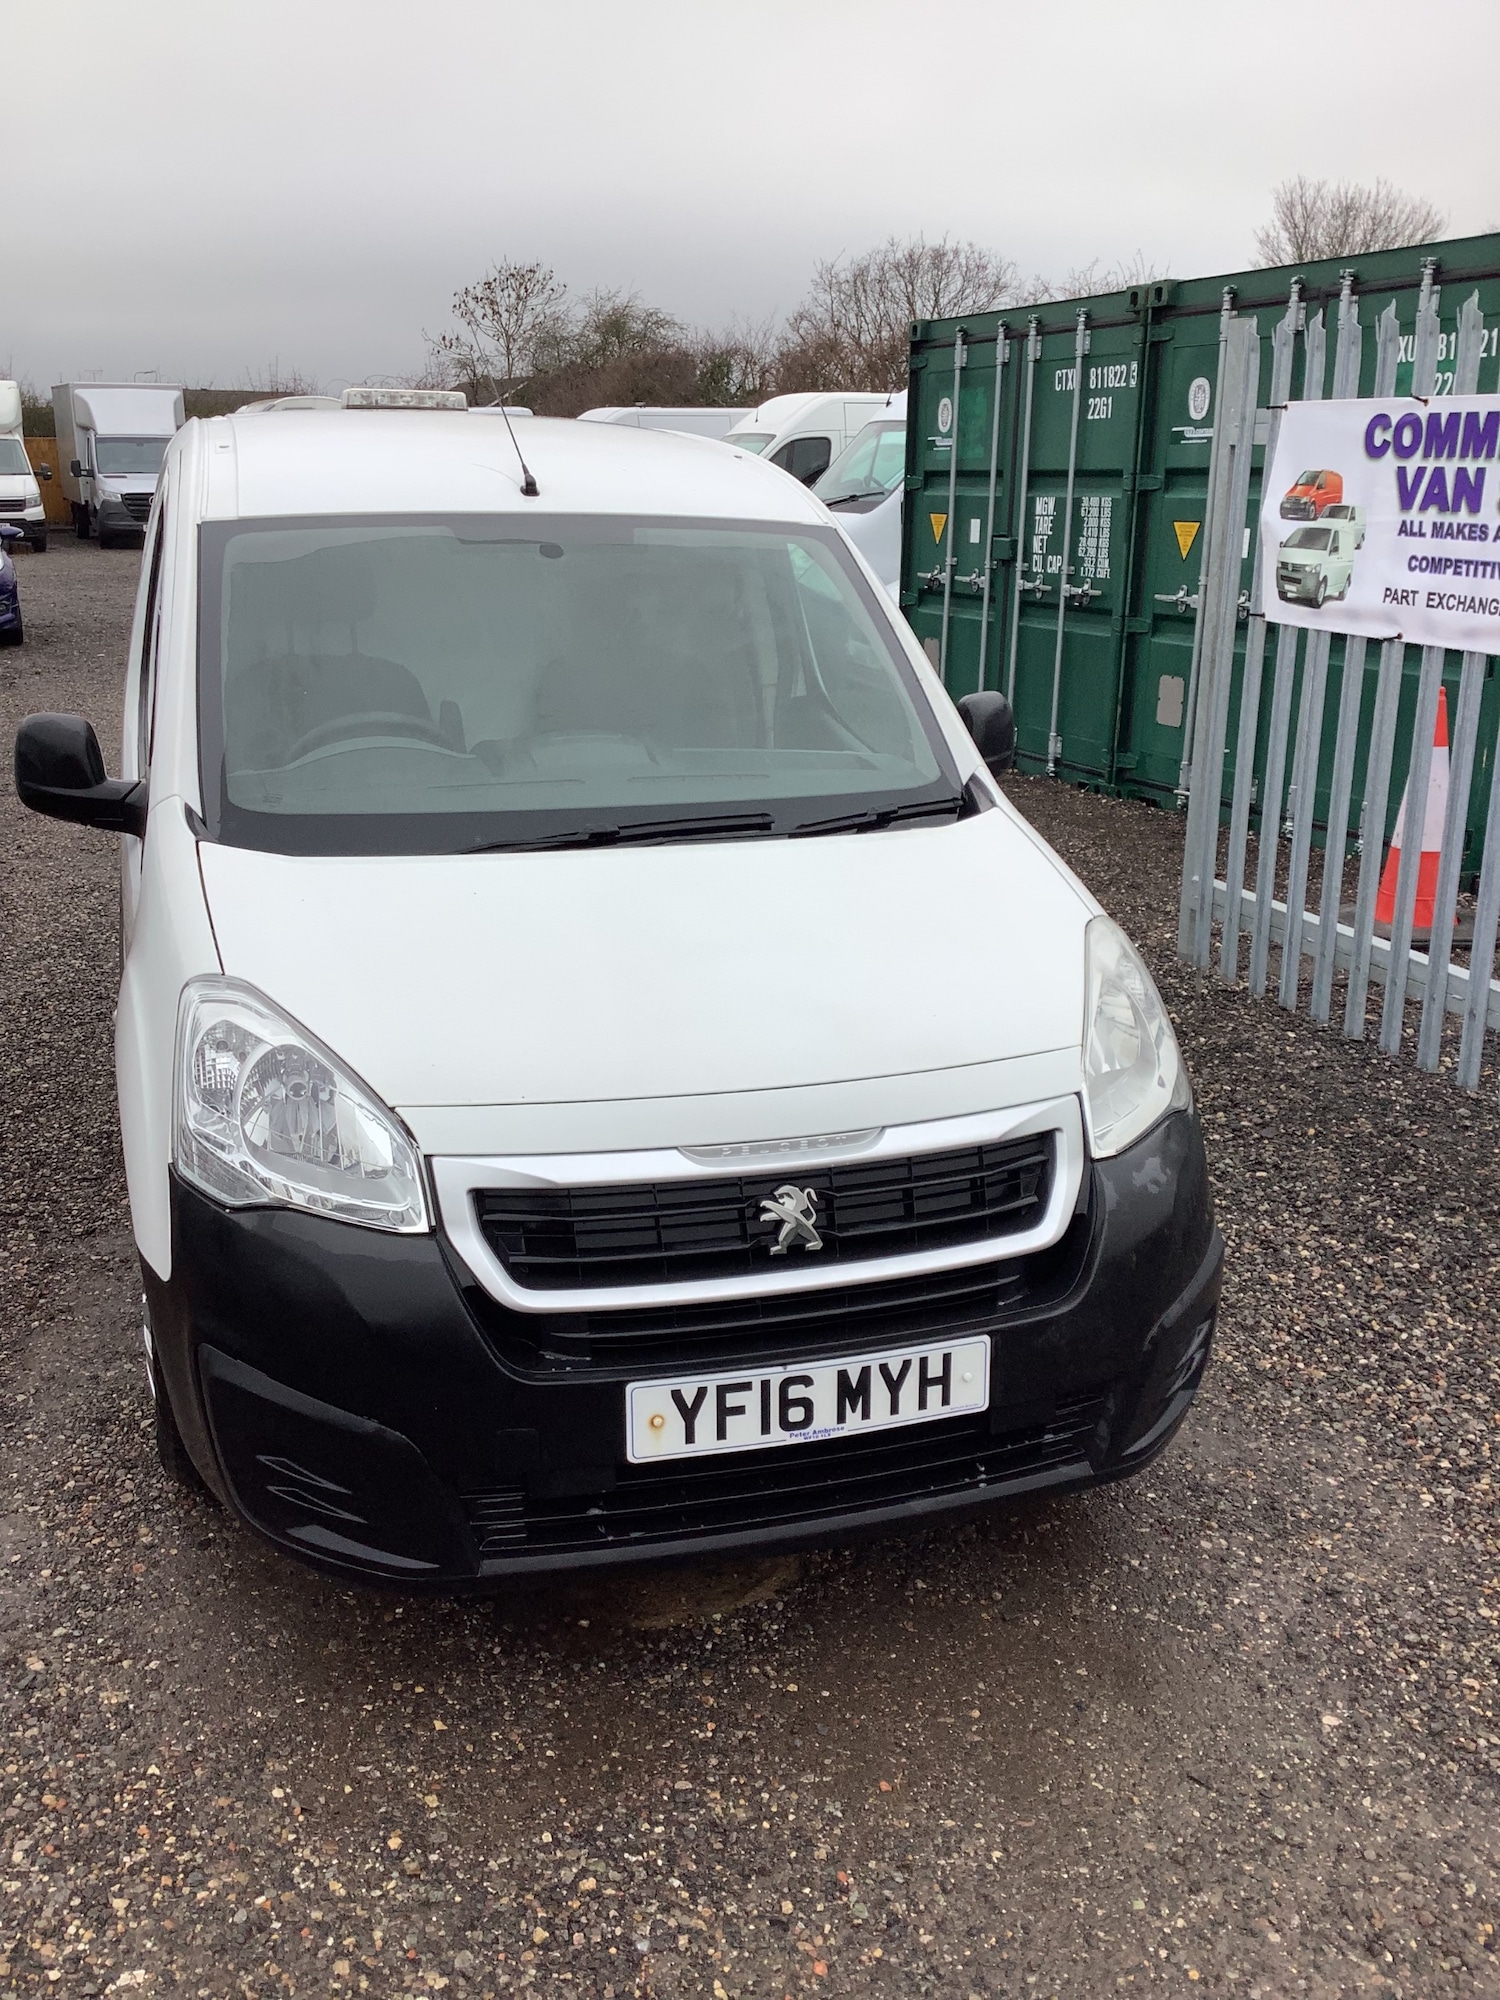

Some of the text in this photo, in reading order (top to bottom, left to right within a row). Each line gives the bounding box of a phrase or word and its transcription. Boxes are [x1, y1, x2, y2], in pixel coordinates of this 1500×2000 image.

[1397, 328, 1499, 363] XU 8121
[1055, 368, 1077, 391] CTX
[1089, 365, 1127, 389] 811822
[1087, 396, 1113, 419] 22G1
[1397, 466, 1487, 513] VAN
[1035, 496, 1057, 516] MGW.
[1035, 516, 1054, 535] TARE
[1397, 520, 1426, 538] ALL
[1430, 521, 1489, 542] MAKES
[1033, 535, 1048, 554] NET
[1407, 554, 1500, 580] COMPETITI
[1382, 587, 1500, 616] PART EXCHANG
[671, 1352, 952, 1445] YF16 MYH
[789, 1426, 845, 1439] Peter Ambrose
